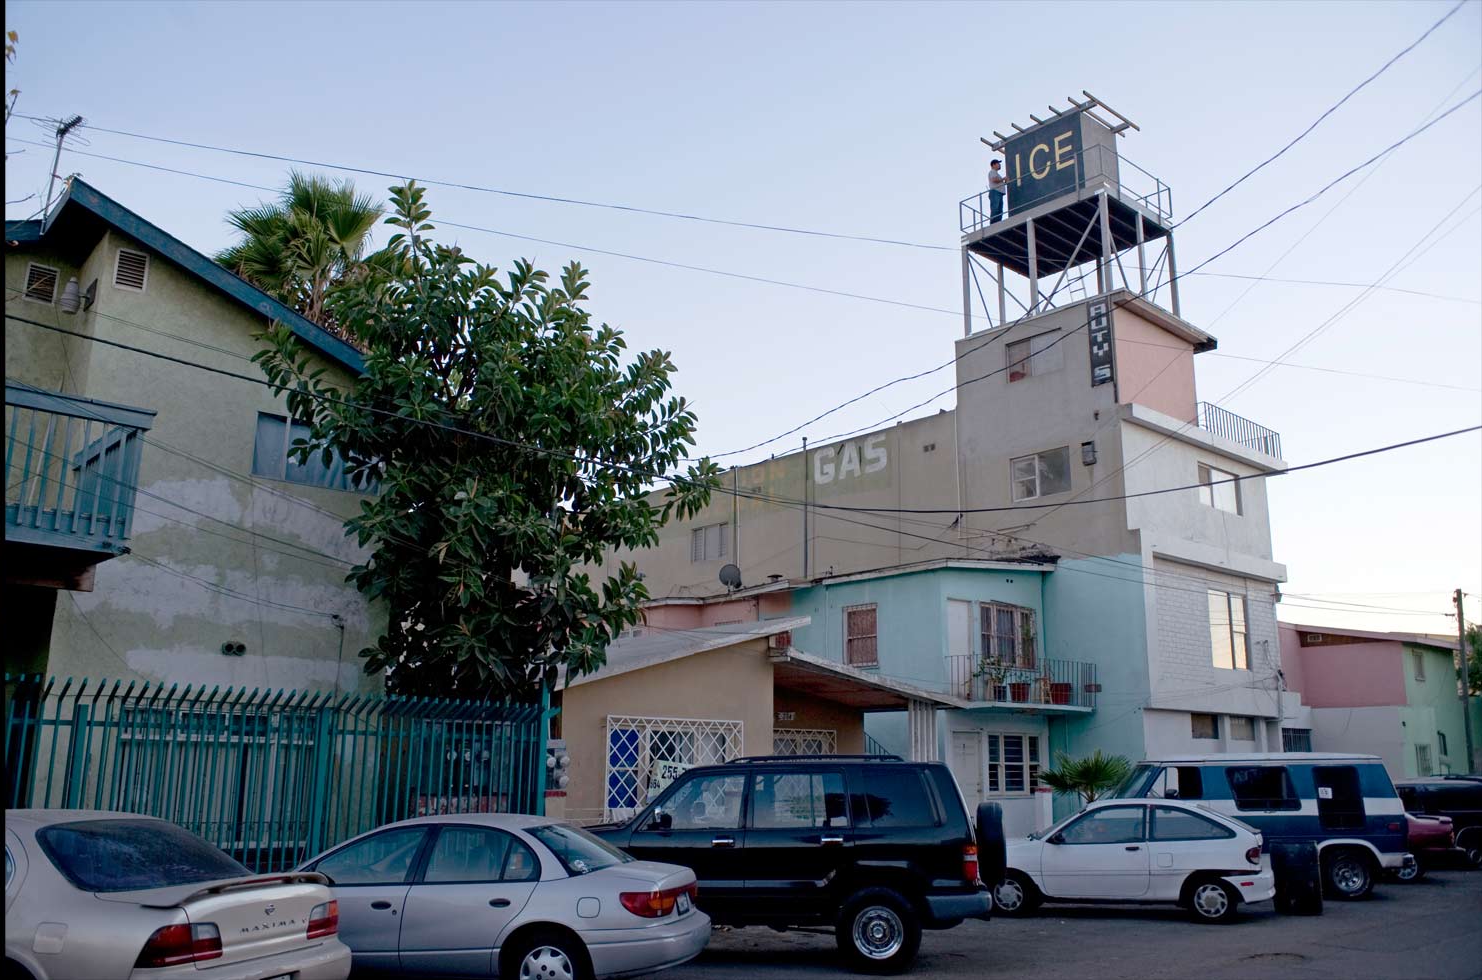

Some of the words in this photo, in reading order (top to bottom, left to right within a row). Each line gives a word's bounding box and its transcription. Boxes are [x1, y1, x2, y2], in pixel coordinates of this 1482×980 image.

[1015, 131, 1075, 187] ICE
[814, 433, 887, 484] GAS
[240, 919, 295, 933] MAXIMA
